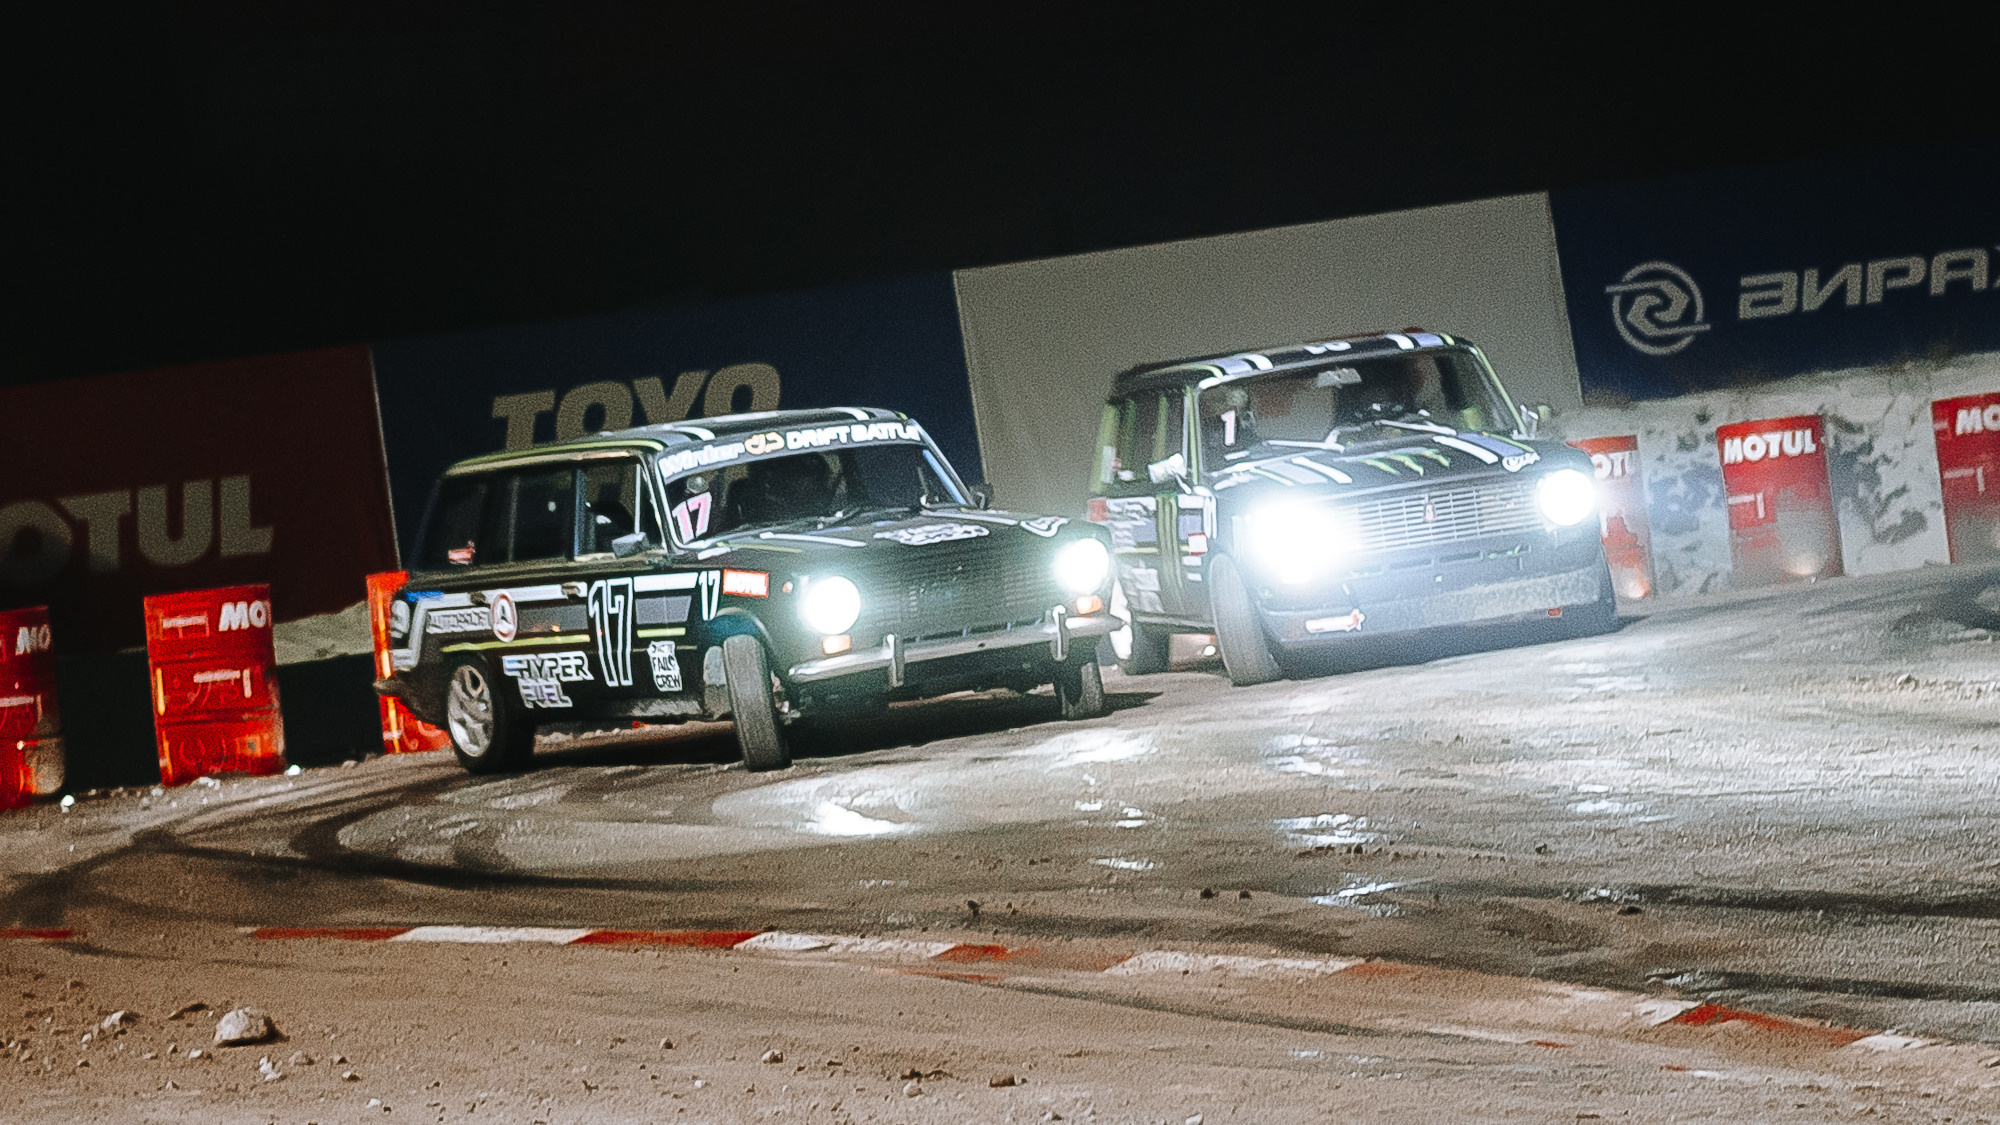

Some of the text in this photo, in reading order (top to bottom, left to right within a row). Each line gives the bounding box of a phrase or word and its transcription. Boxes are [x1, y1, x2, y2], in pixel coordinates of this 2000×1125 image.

[1739, 246, 2000, 319] ВИРА
[491, 363, 780, 450] TOYO
[1956, 405, 2000, 435] MO
[786, 425, 850, 450] DRIFT
[1221, 410, 1235, 446] 1
[1723, 429, 1817, 464] MOTUL
[672, 492, 712, 544] 17
[699, 570, 720, 621] 17
[219, 600, 271, 631] MO
[588, 577, 633, 687] 17
[15, 624, 50, 655] MO
[507, 655, 591, 682] HYPER
[656, 673, 681, 689] CREW
